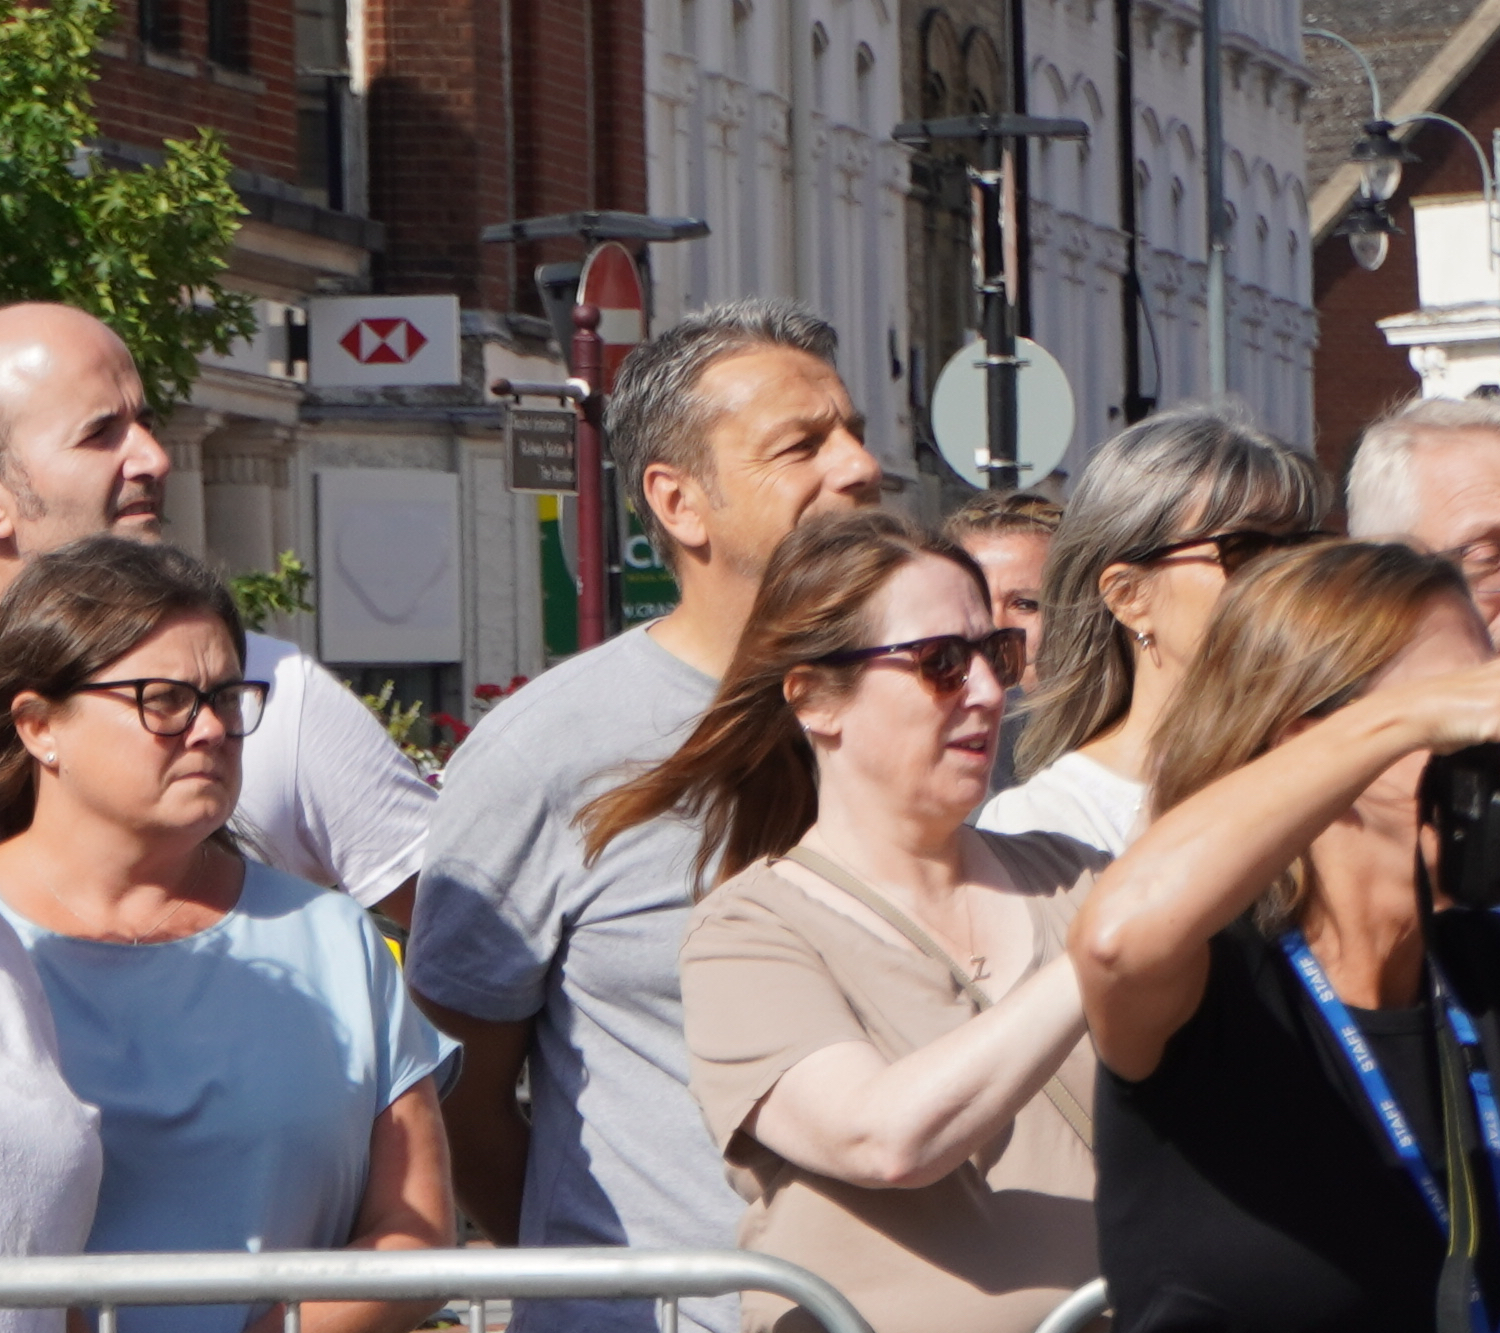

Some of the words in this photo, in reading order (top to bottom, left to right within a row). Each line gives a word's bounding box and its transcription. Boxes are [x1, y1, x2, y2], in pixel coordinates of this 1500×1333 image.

[1298, 956, 1335, 1004] STAFF
[1341, 1024, 1377, 1074] STAFF
[1380, 1098, 1414, 1148] STAFF
